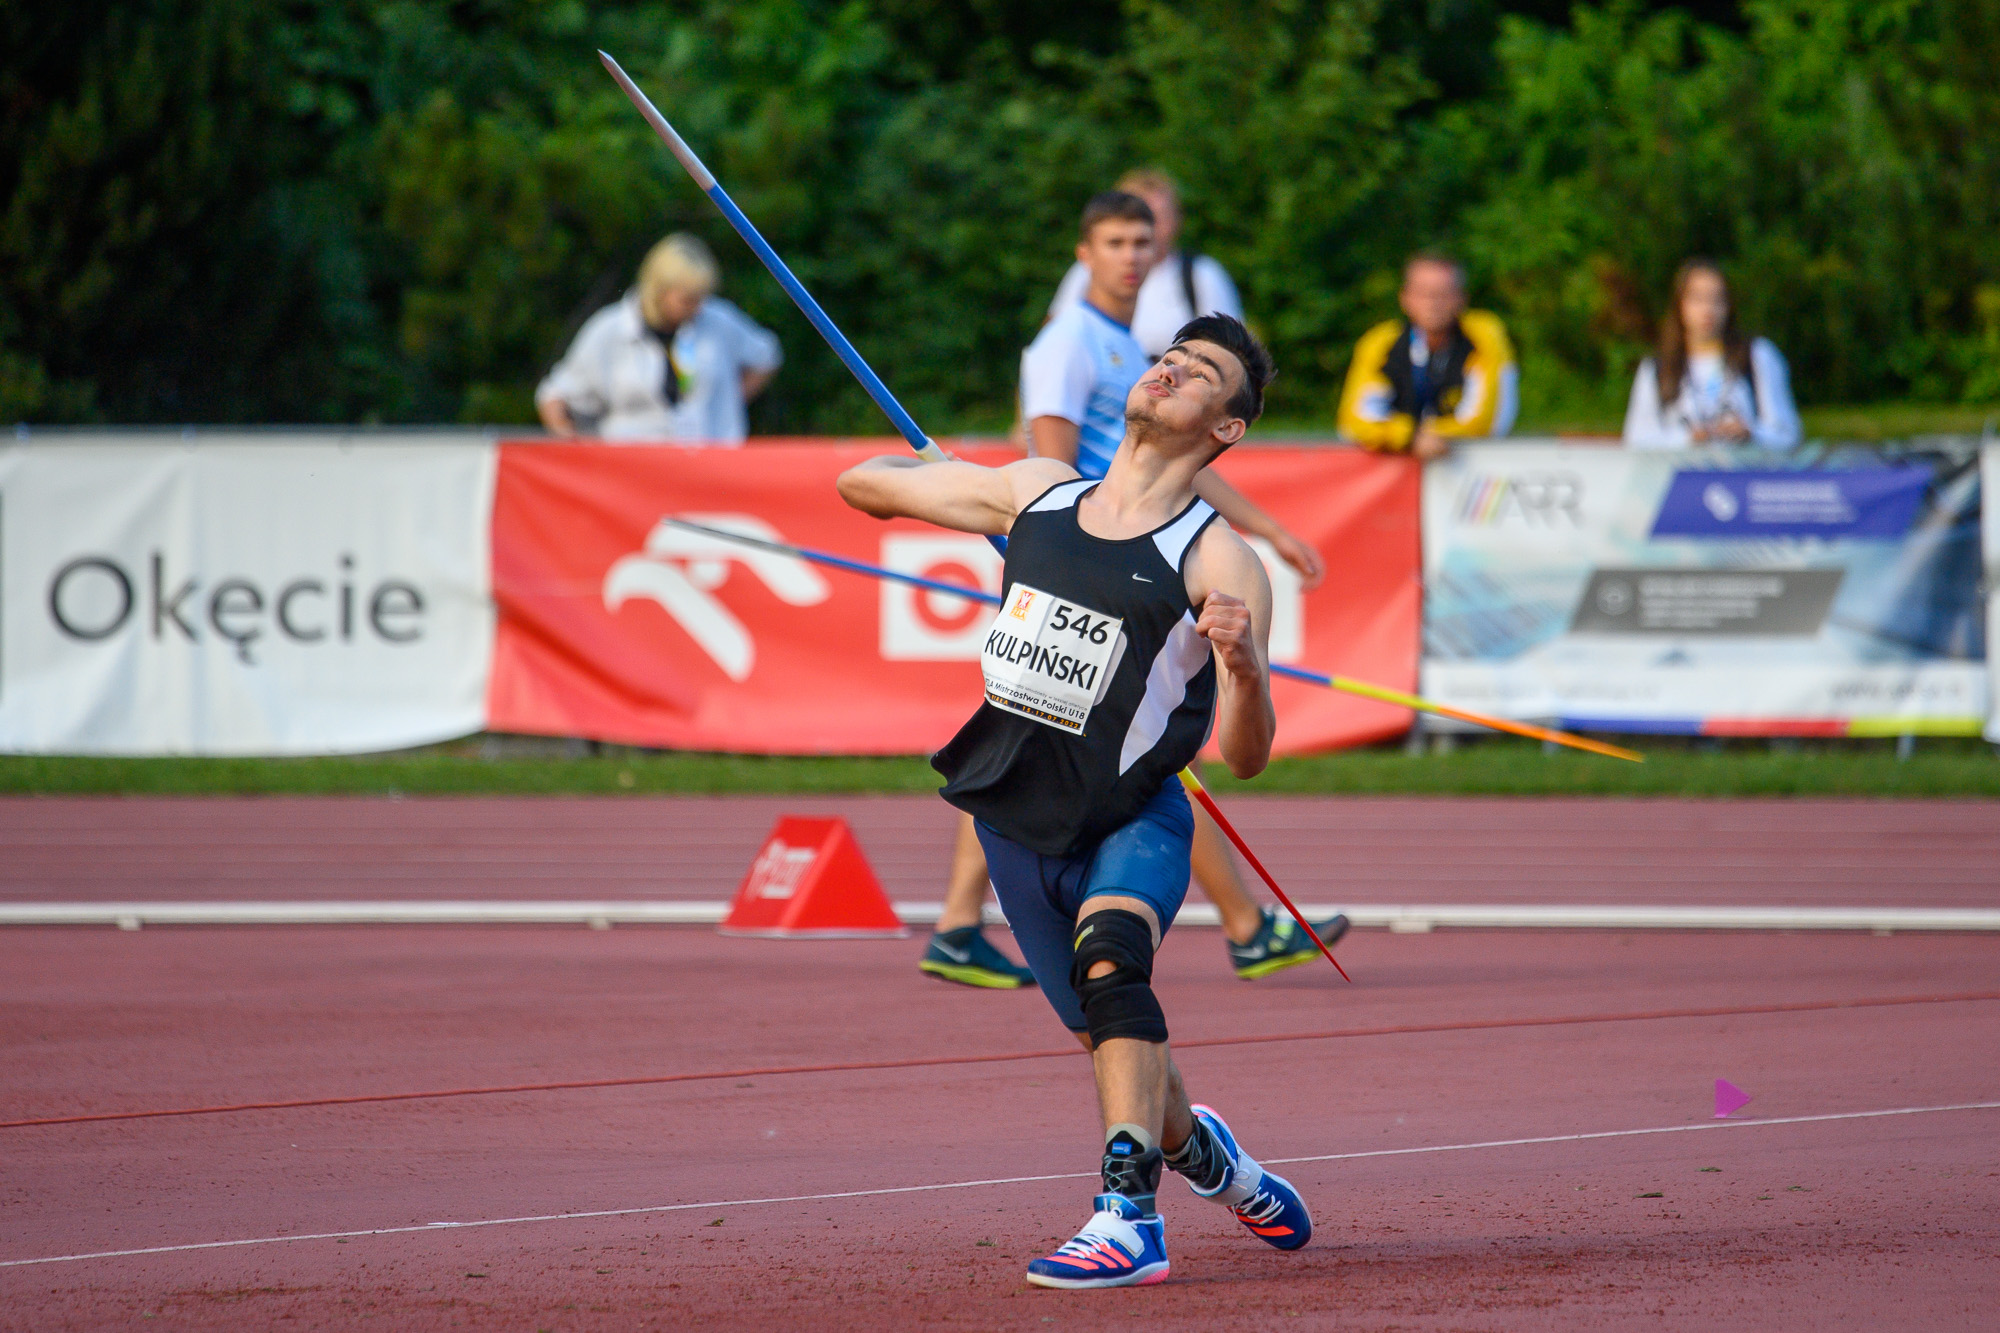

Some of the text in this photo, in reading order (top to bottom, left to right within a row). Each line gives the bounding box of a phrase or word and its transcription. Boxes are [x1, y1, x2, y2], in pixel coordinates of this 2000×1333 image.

[47, 549, 424, 666] Okęcie
[1050, 605, 1110, 645] 546
[984, 629, 1099, 691] KULPIŃSKI
[994, 682, 1040, 705] Mistrzostwa
[1041, 699, 1067, 715] Polski
[1068, 708, 1085, 720] U18
